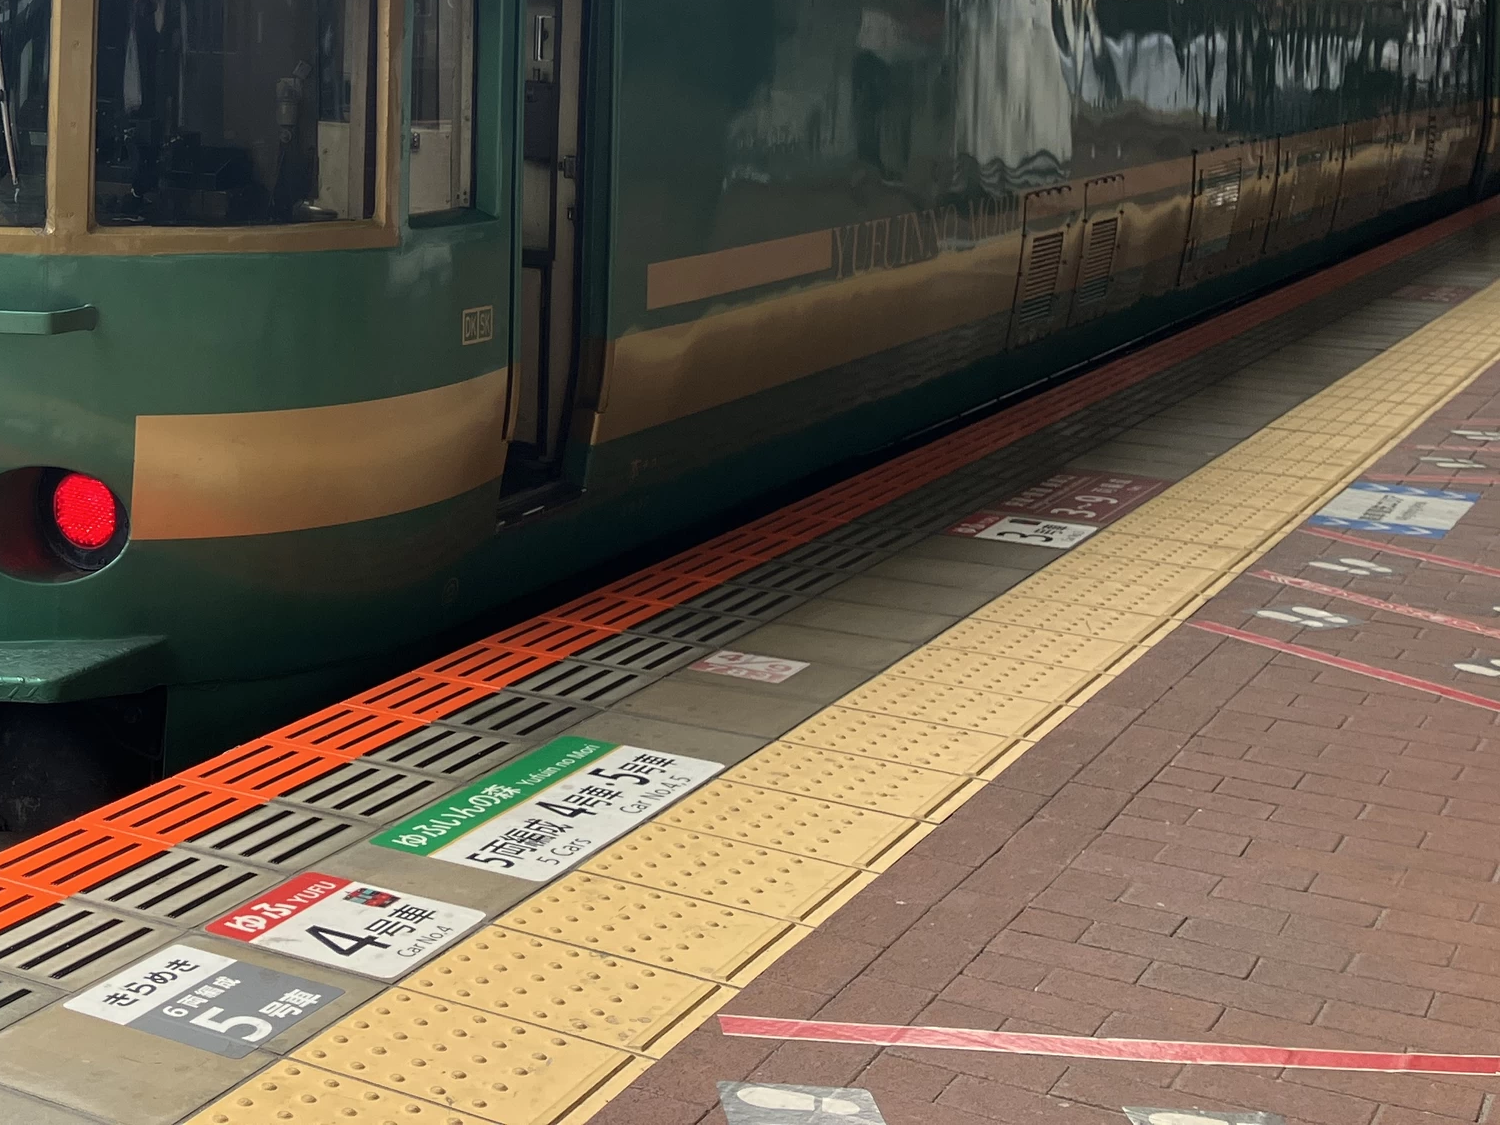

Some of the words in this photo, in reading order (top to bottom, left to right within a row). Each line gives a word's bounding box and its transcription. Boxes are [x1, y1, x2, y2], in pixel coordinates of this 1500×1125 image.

[392, 783, 522, 848] ゆふいんの森
[516, 764, 559, 786] Yufuin
[556, 756, 576, 769] no
[573, 743, 601, 762] Mori
[466, 818, 574, 869] 5両編成
[537, 855, 560, 866] 5
[551, 837, 592, 857] Cars
[619, 797, 647, 815] Car
[223, 902, 298, 933] ゆふ
[286, 880, 337, 904] YUFU
[305, 903, 438, 957] 4号車
[397, 942, 424, 959] Car
[416, 924, 454, 950] No.4
[102, 958, 200, 1007] きらめき
[189, 988, 322, 1042] 5号車
